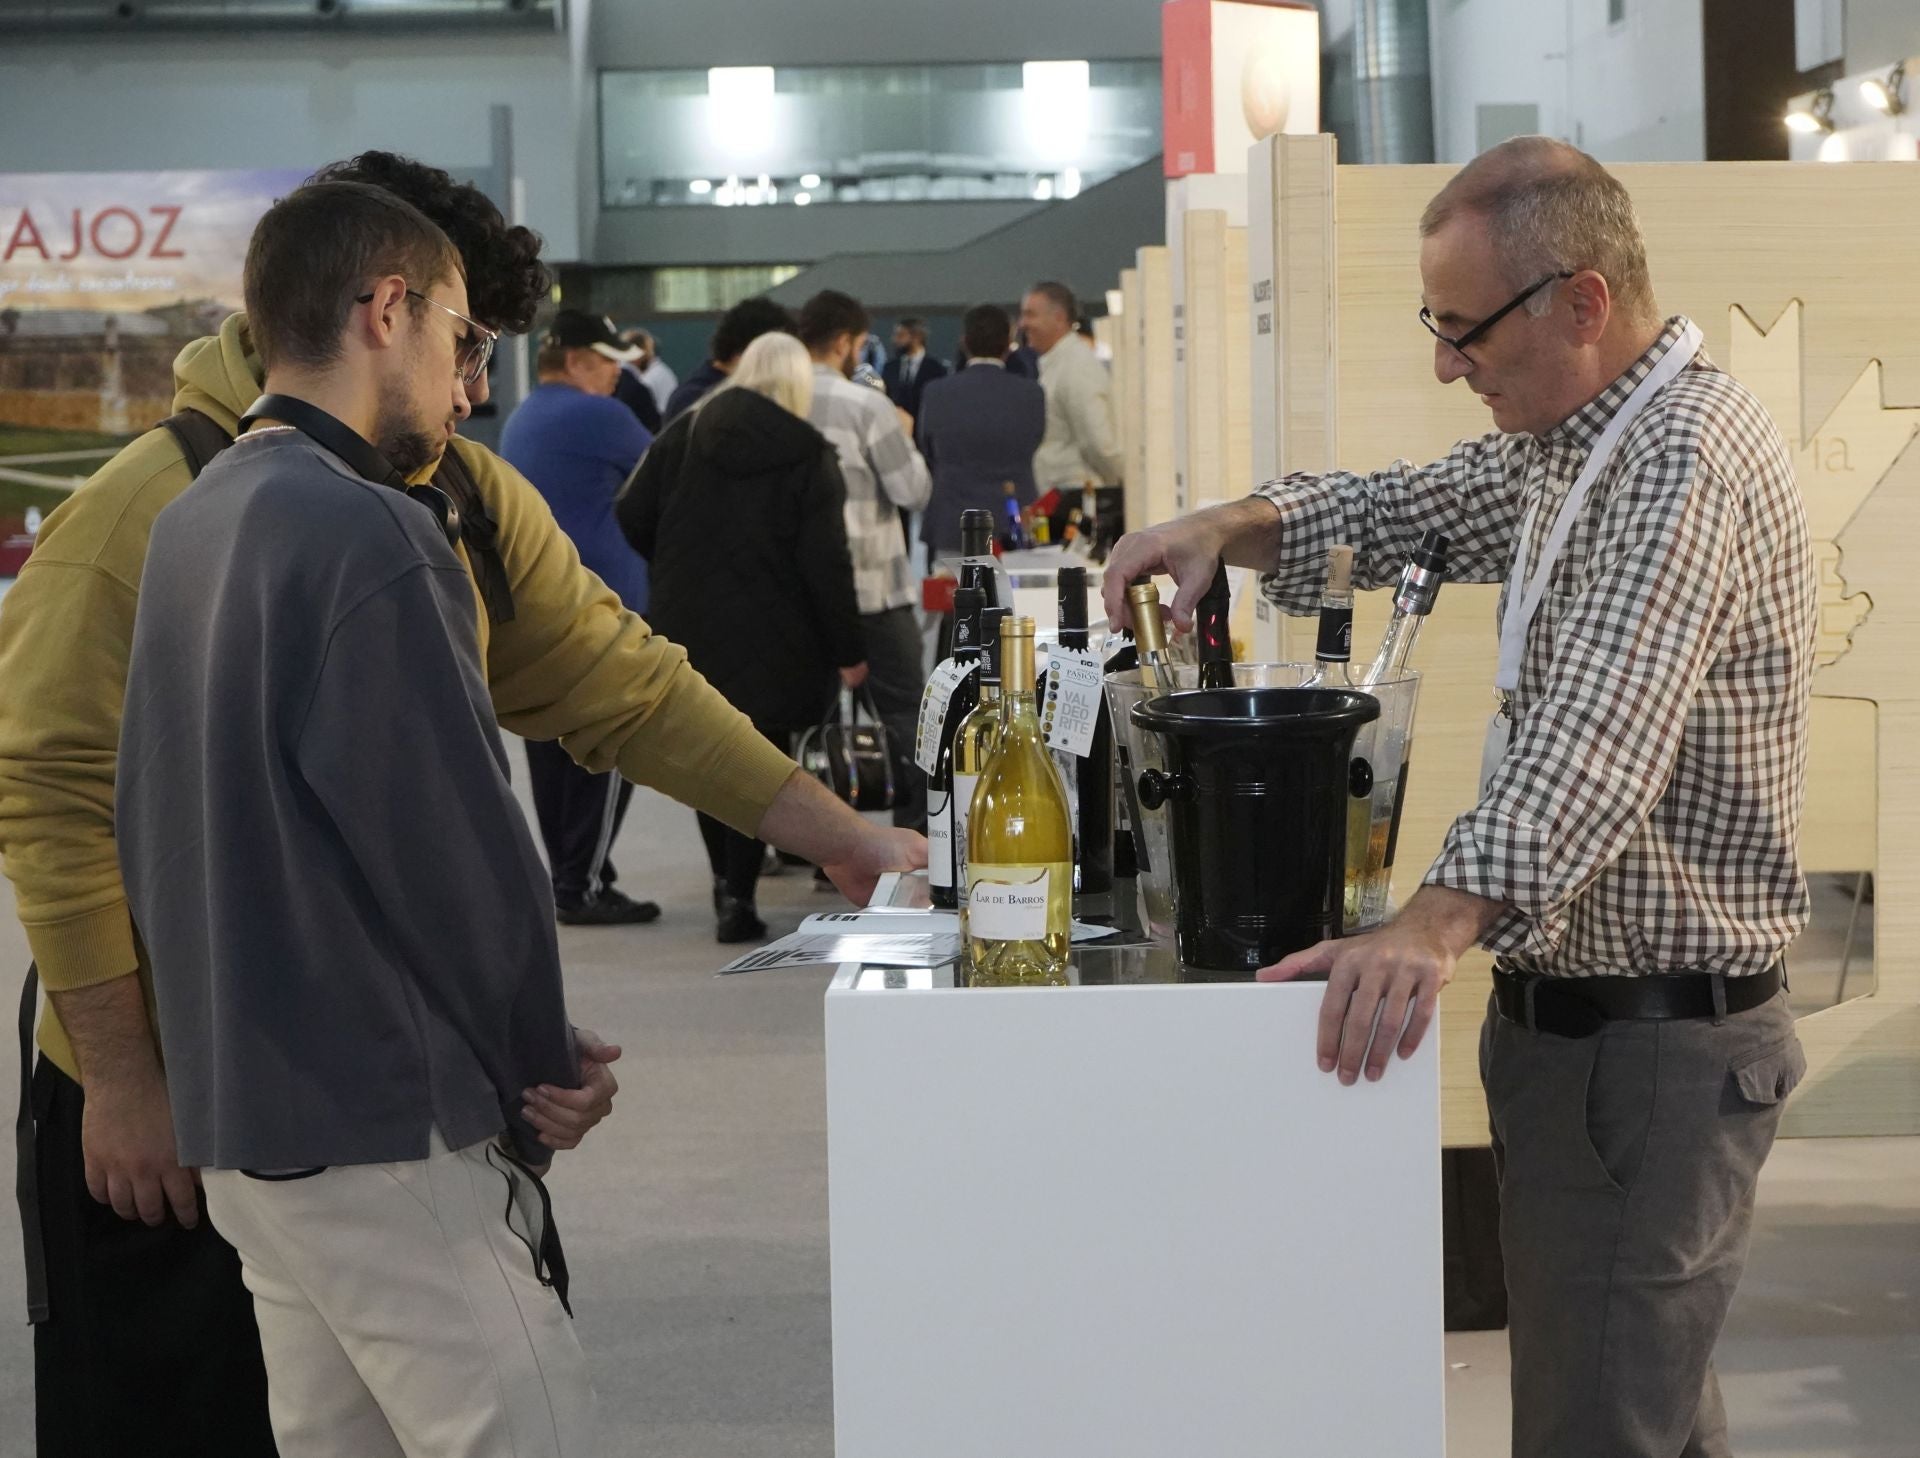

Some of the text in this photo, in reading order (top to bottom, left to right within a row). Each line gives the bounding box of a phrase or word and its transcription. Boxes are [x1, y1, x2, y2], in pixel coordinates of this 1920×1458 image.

[0, 203, 187, 263] AJOZ
[1065, 689, 1089, 708] VAL
[1061, 703, 1089, 721] DEO
[1059, 715, 1090, 736] RITE
[976, 891, 1045, 905] LAR DE BARROS
